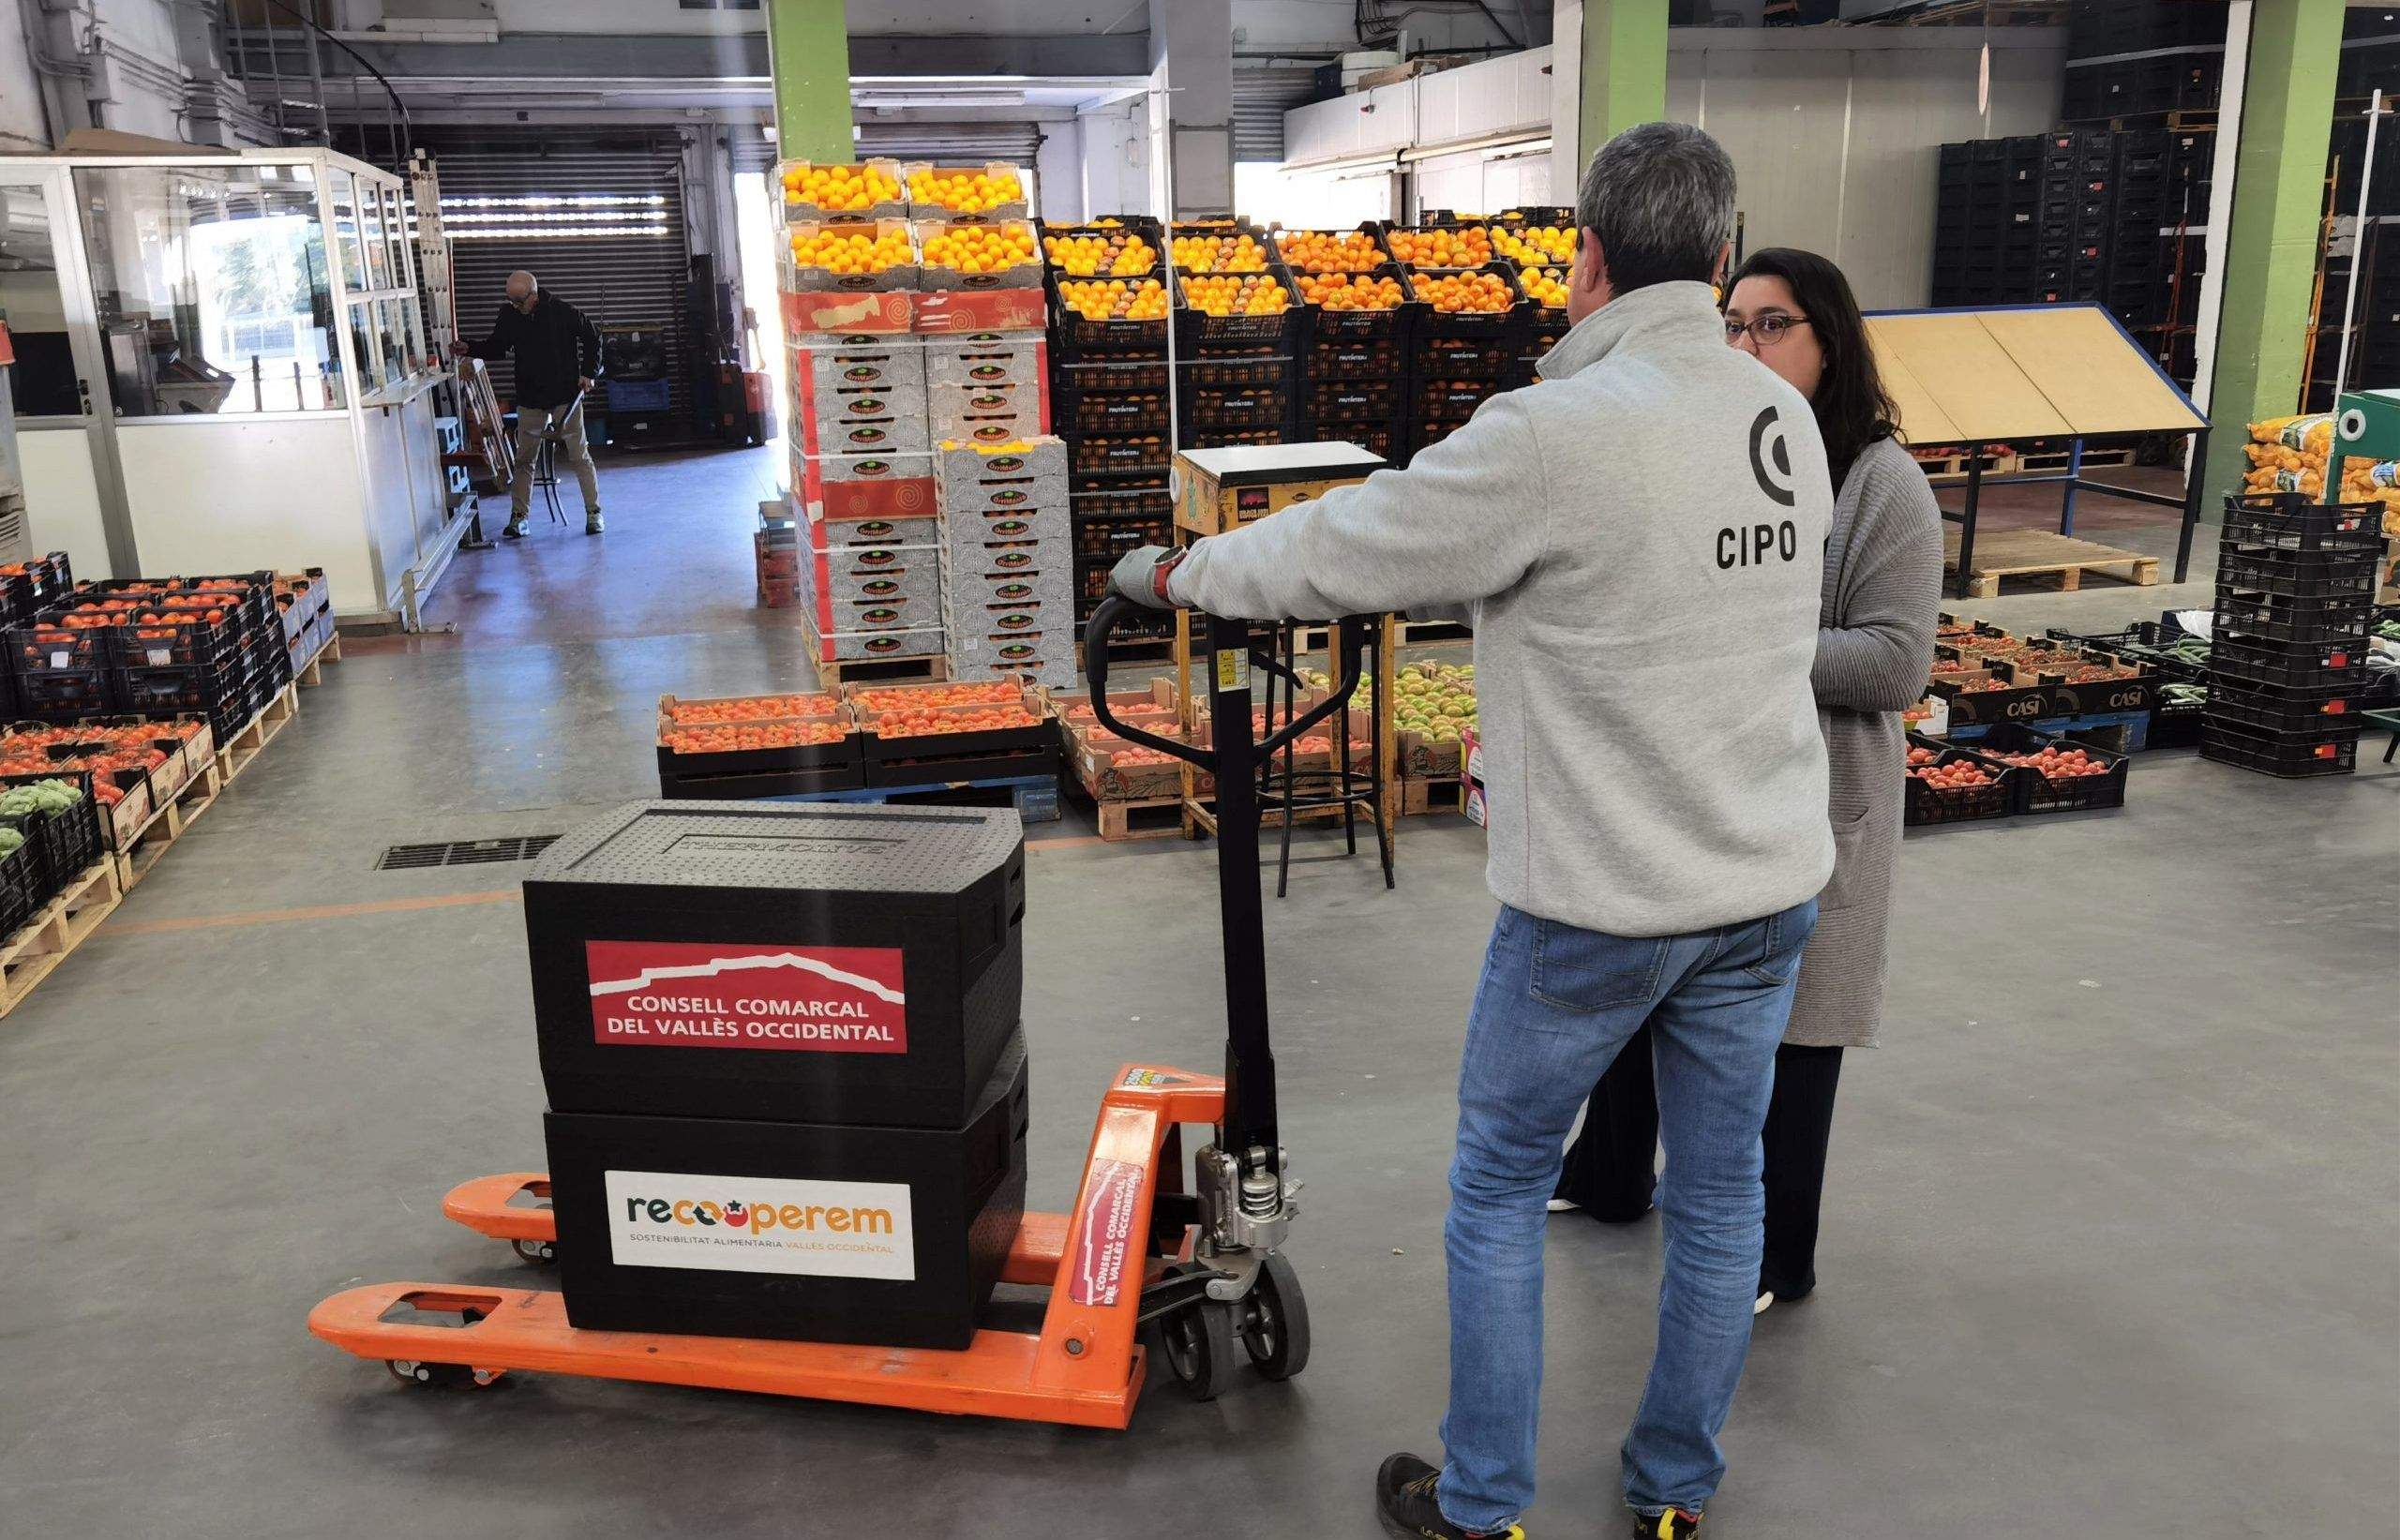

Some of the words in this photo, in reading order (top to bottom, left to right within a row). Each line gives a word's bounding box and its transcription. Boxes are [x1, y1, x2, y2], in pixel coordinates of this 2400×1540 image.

[1717, 520, 1796, 569] CIPO
[2007, 700, 2040, 717] CASI
[2109, 692, 2142, 708] CASI
[627, 995, 728, 1015] CONSELL
[735, 998, 869, 1018] COMARCAL
[608, 1017, 650, 1035] DEL
[655, 1017, 739, 1037] VALLÈS
[745, 1022, 894, 1041] OCCIDENTAL
[630, 1233, 711, 1245] SOSTENIBILITAT
[713, 1238, 783, 1248] ALIMENTARIA
[827, 1241, 895, 1253] OCCIDENTAL
[1096, 1243, 1114, 1292] CONSELL
[1106, 1179, 1127, 1239] COMARCAL
[1103, 1284, 1117, 1305] DEL
